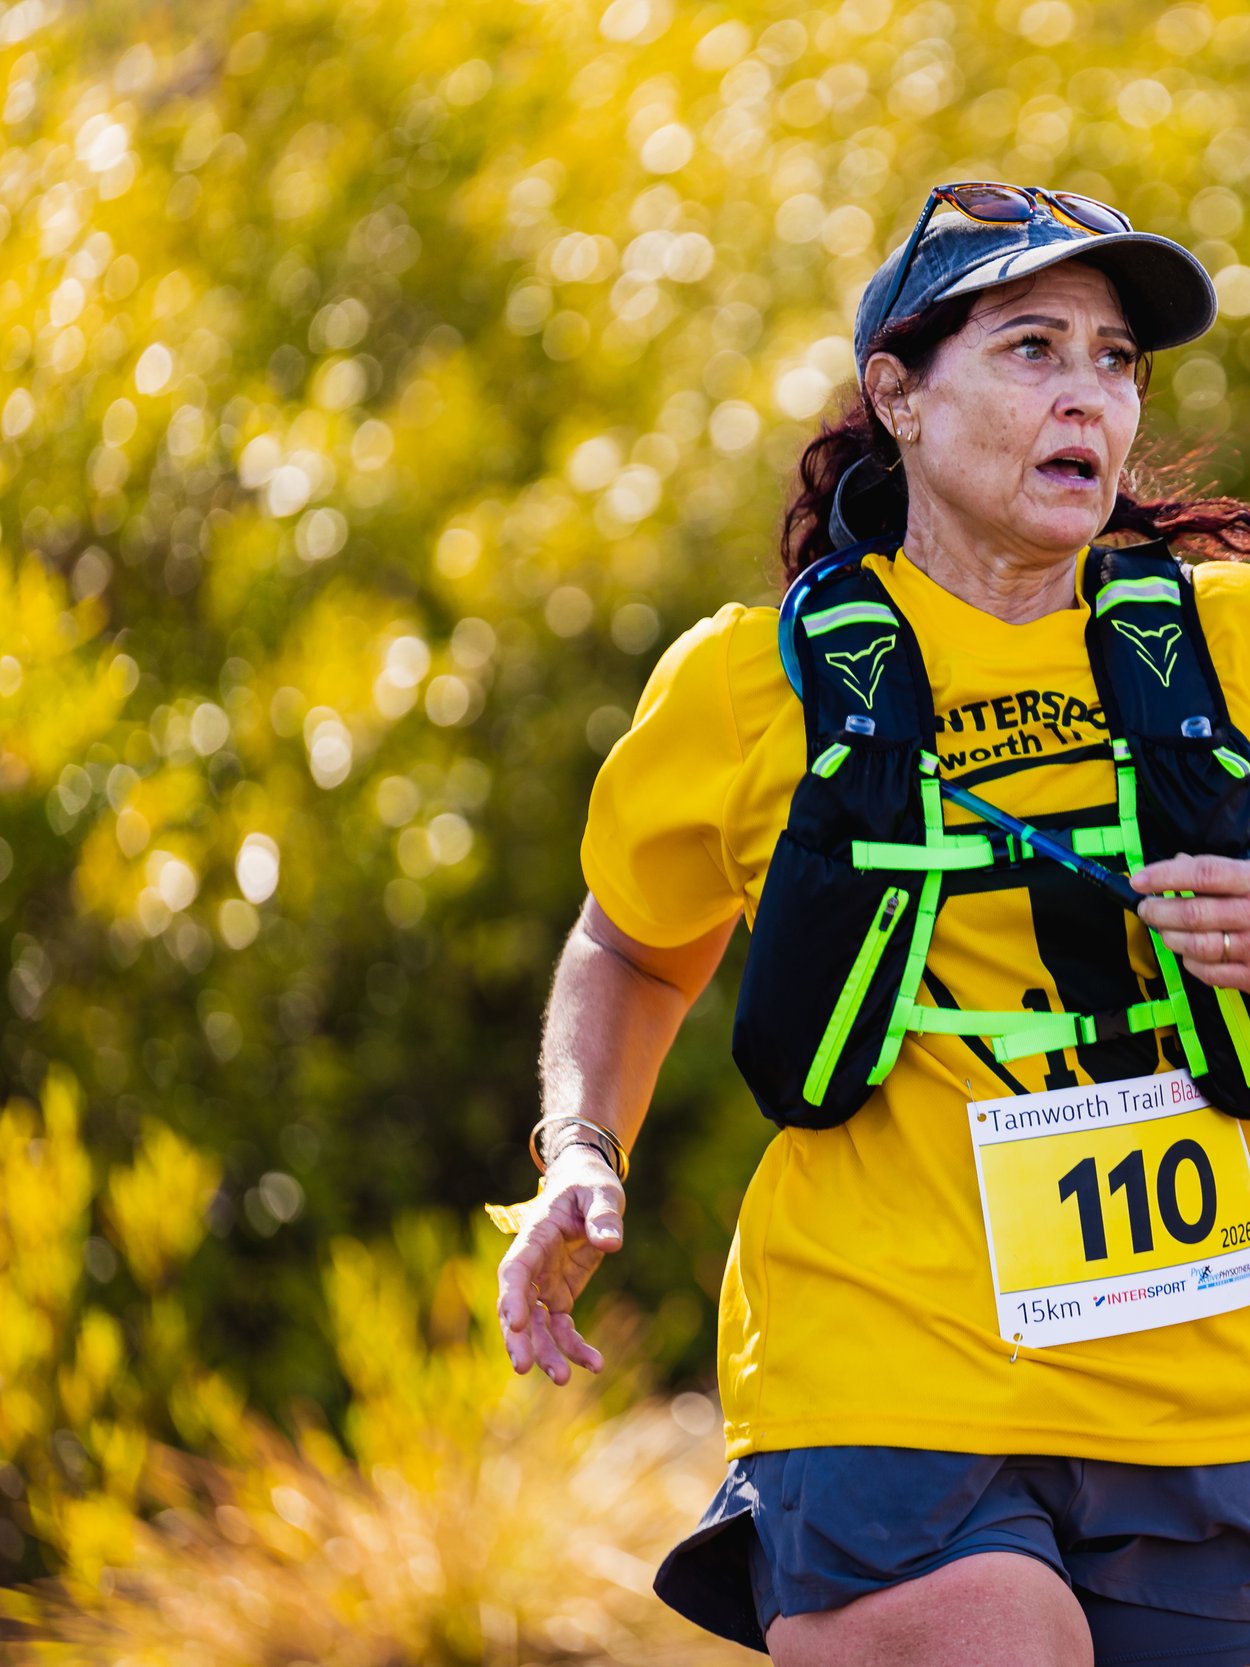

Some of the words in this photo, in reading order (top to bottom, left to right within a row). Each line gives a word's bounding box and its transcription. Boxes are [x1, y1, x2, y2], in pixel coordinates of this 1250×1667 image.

[935, 690, 1107, 732] NTERSPO
[940, 729, 1043, 771] worth
[988, 1094, 1109, 1132] Tamworth
[1117, 1084, 1165, 1114] Trail
[1058, 1139, 1217, 1262] 110
[1016, 1298, 1082, 1325] 15km
[1107, 1280, 1187, 1306] INTERSPORT
